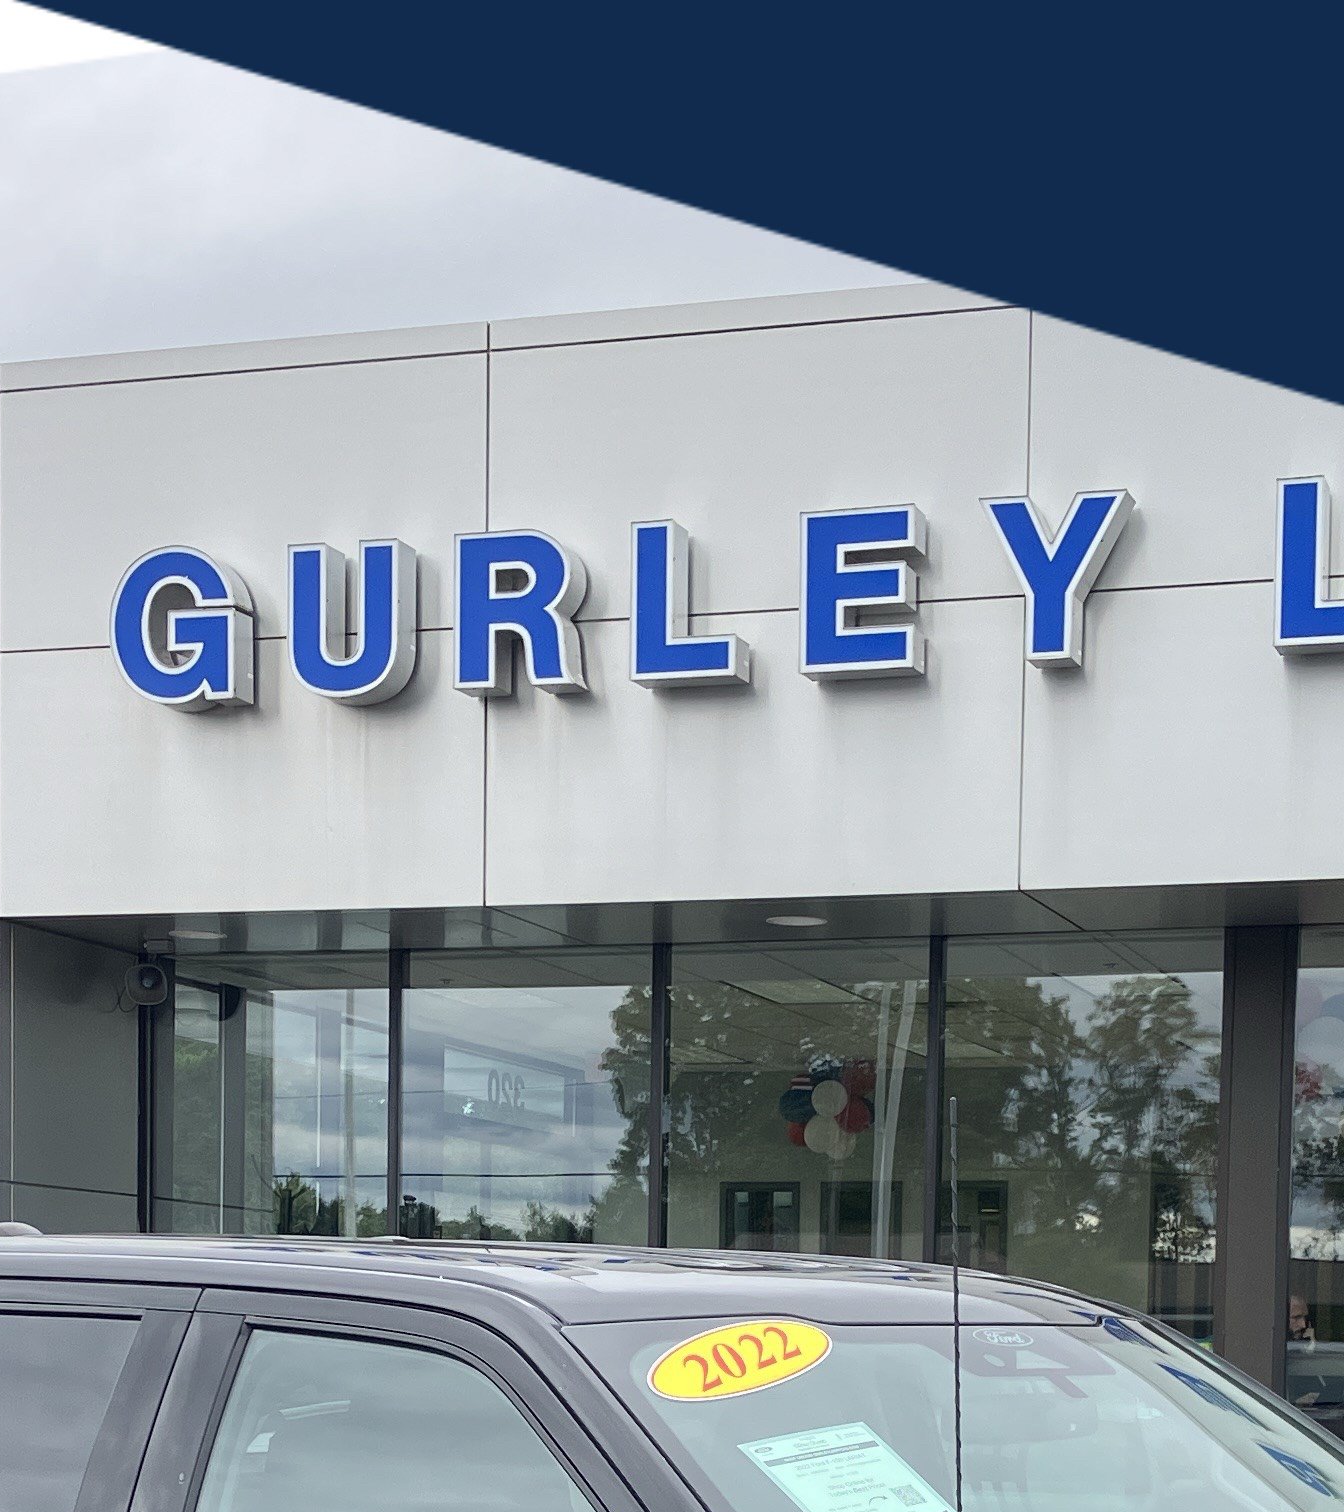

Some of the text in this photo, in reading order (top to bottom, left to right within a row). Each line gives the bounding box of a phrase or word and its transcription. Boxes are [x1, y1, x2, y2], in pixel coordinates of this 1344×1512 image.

[110, 489, 1137, 712] GURLEY
[682, 1326, 802, 1392] 2022
[983, 1330, 1025, 1344] Ford
